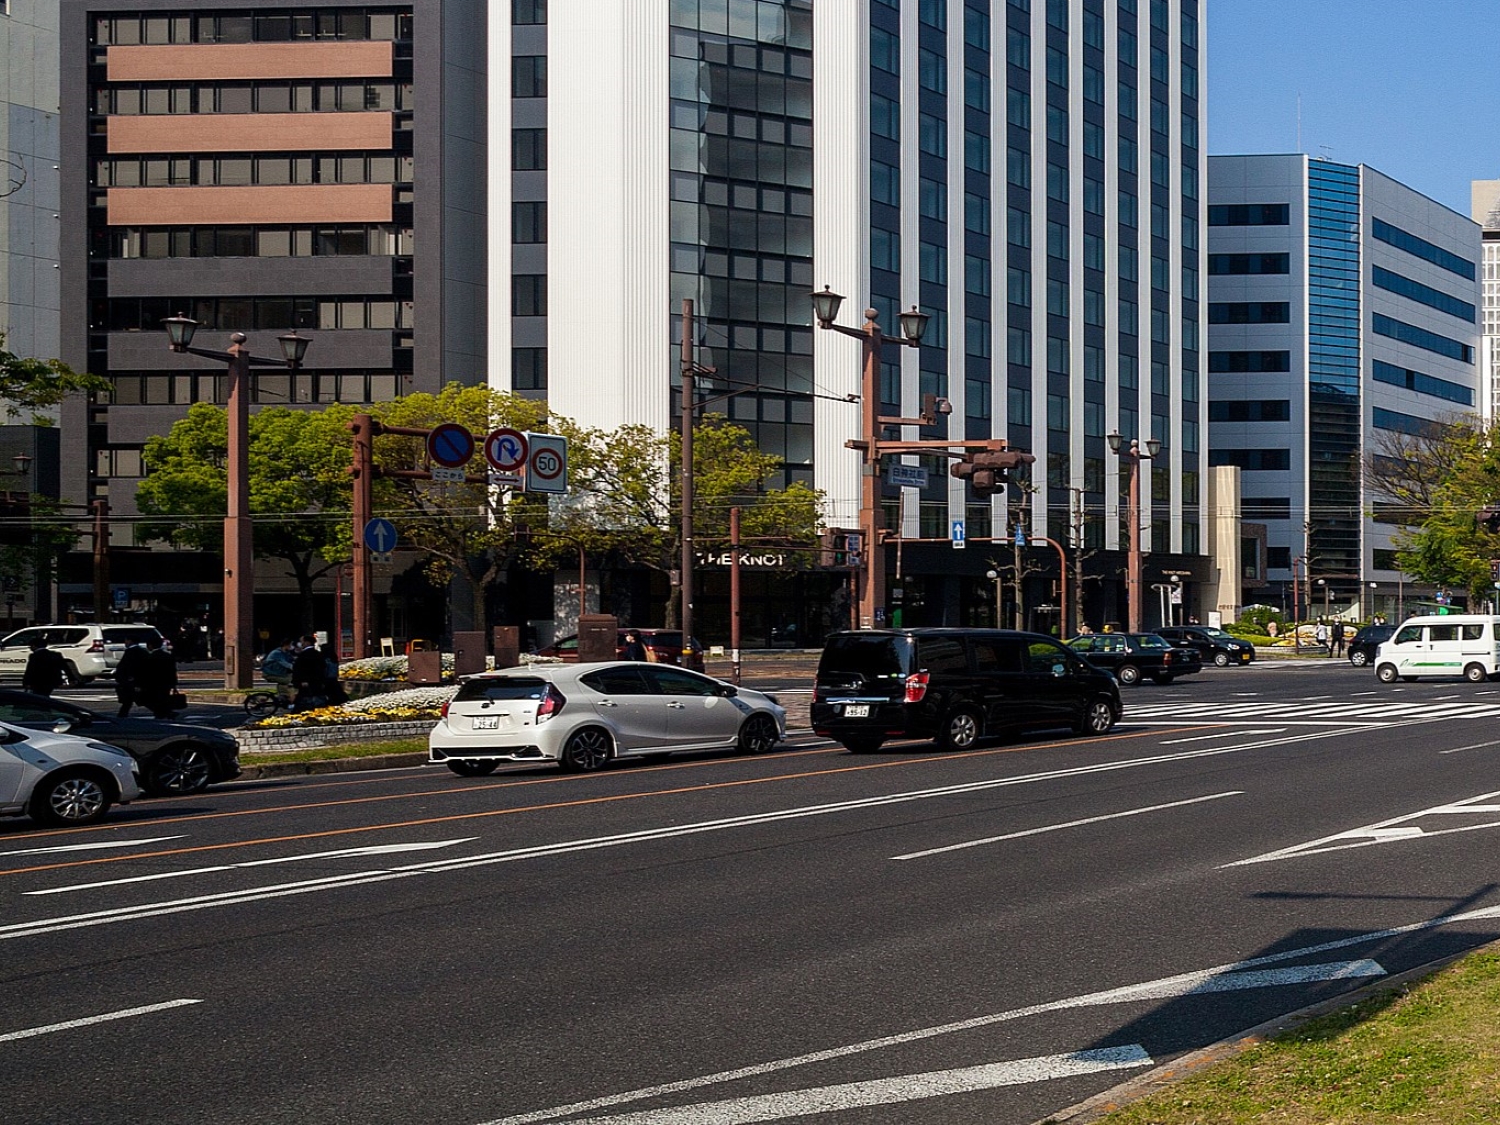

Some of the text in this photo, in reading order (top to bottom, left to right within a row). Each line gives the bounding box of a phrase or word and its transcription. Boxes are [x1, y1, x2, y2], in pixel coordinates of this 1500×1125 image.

[538, 456, 557, 471] 50
[435, 472, 463, 480] ここから
